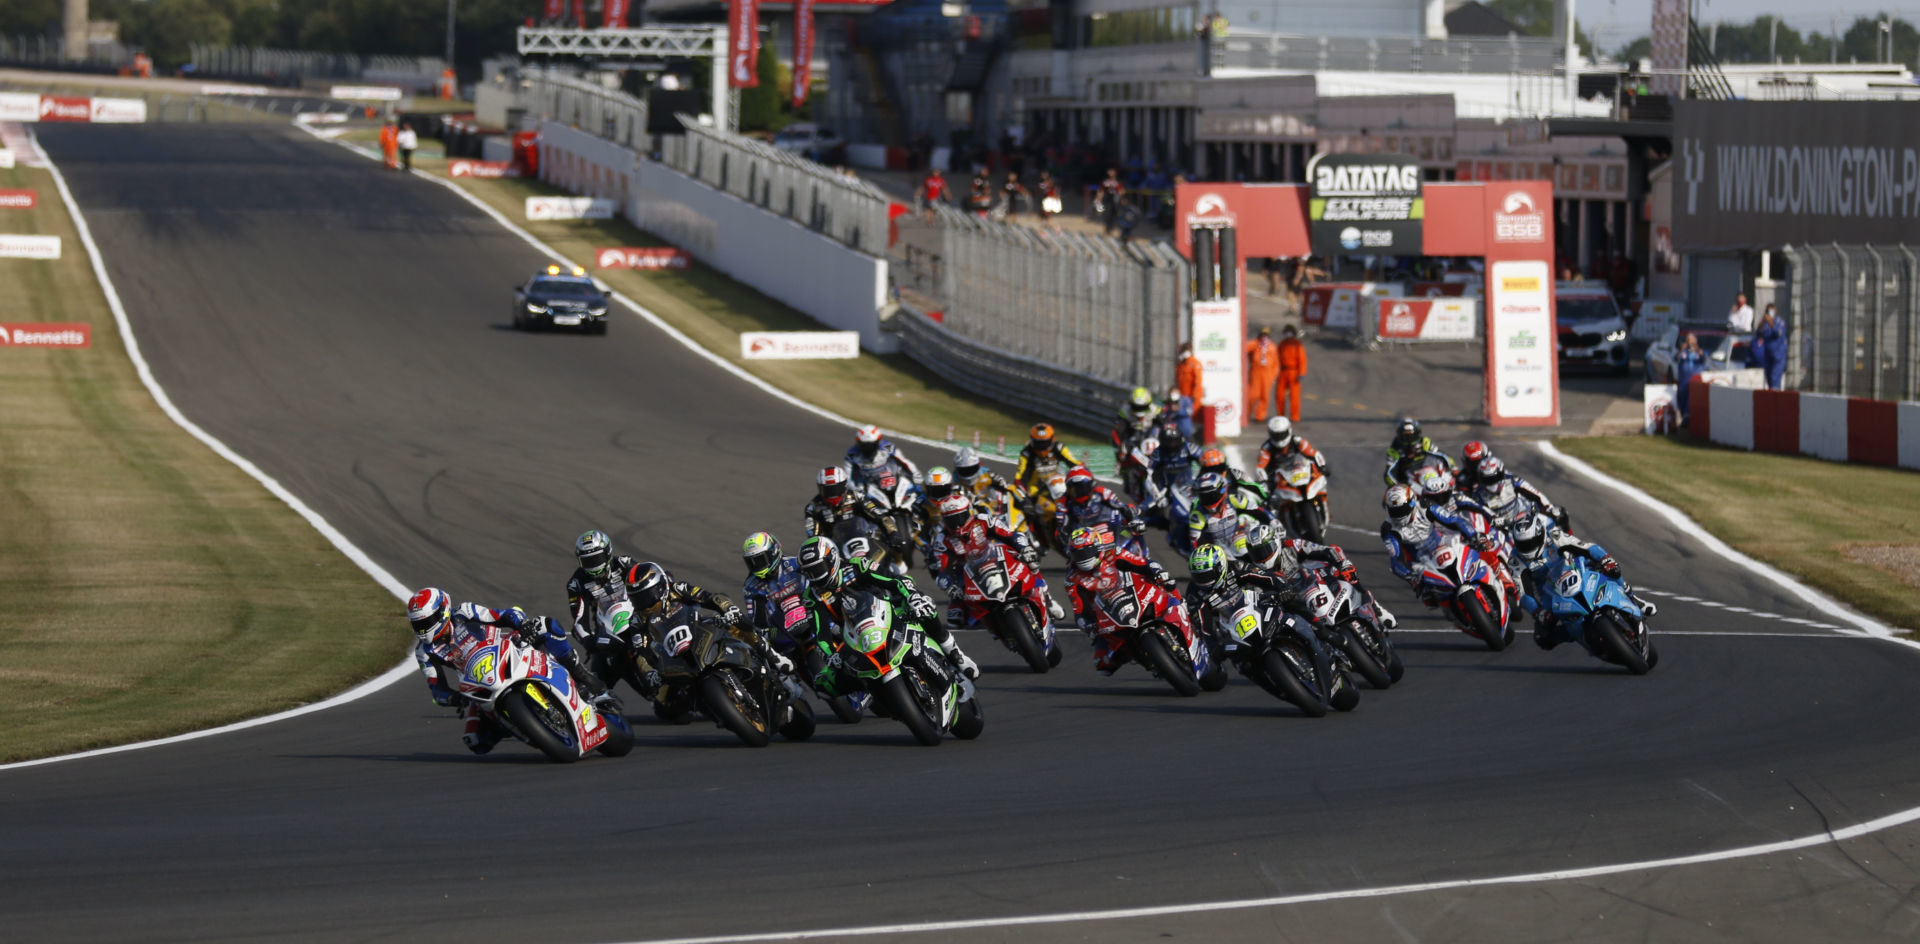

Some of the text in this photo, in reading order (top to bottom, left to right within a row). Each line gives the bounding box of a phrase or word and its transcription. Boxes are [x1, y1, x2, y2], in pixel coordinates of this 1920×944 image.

[1317, 165, 1418, 191] DATATAG
[1326, 198, 1412, 210] EXTREME
[1498, 224, 1542, 237] BSB
[13, 328, 84, 344] Bennetts
[611, 610, 630, 636] 2
[1235, 614, 1257, 639] 18
[472, 654, 494, 683] 77
